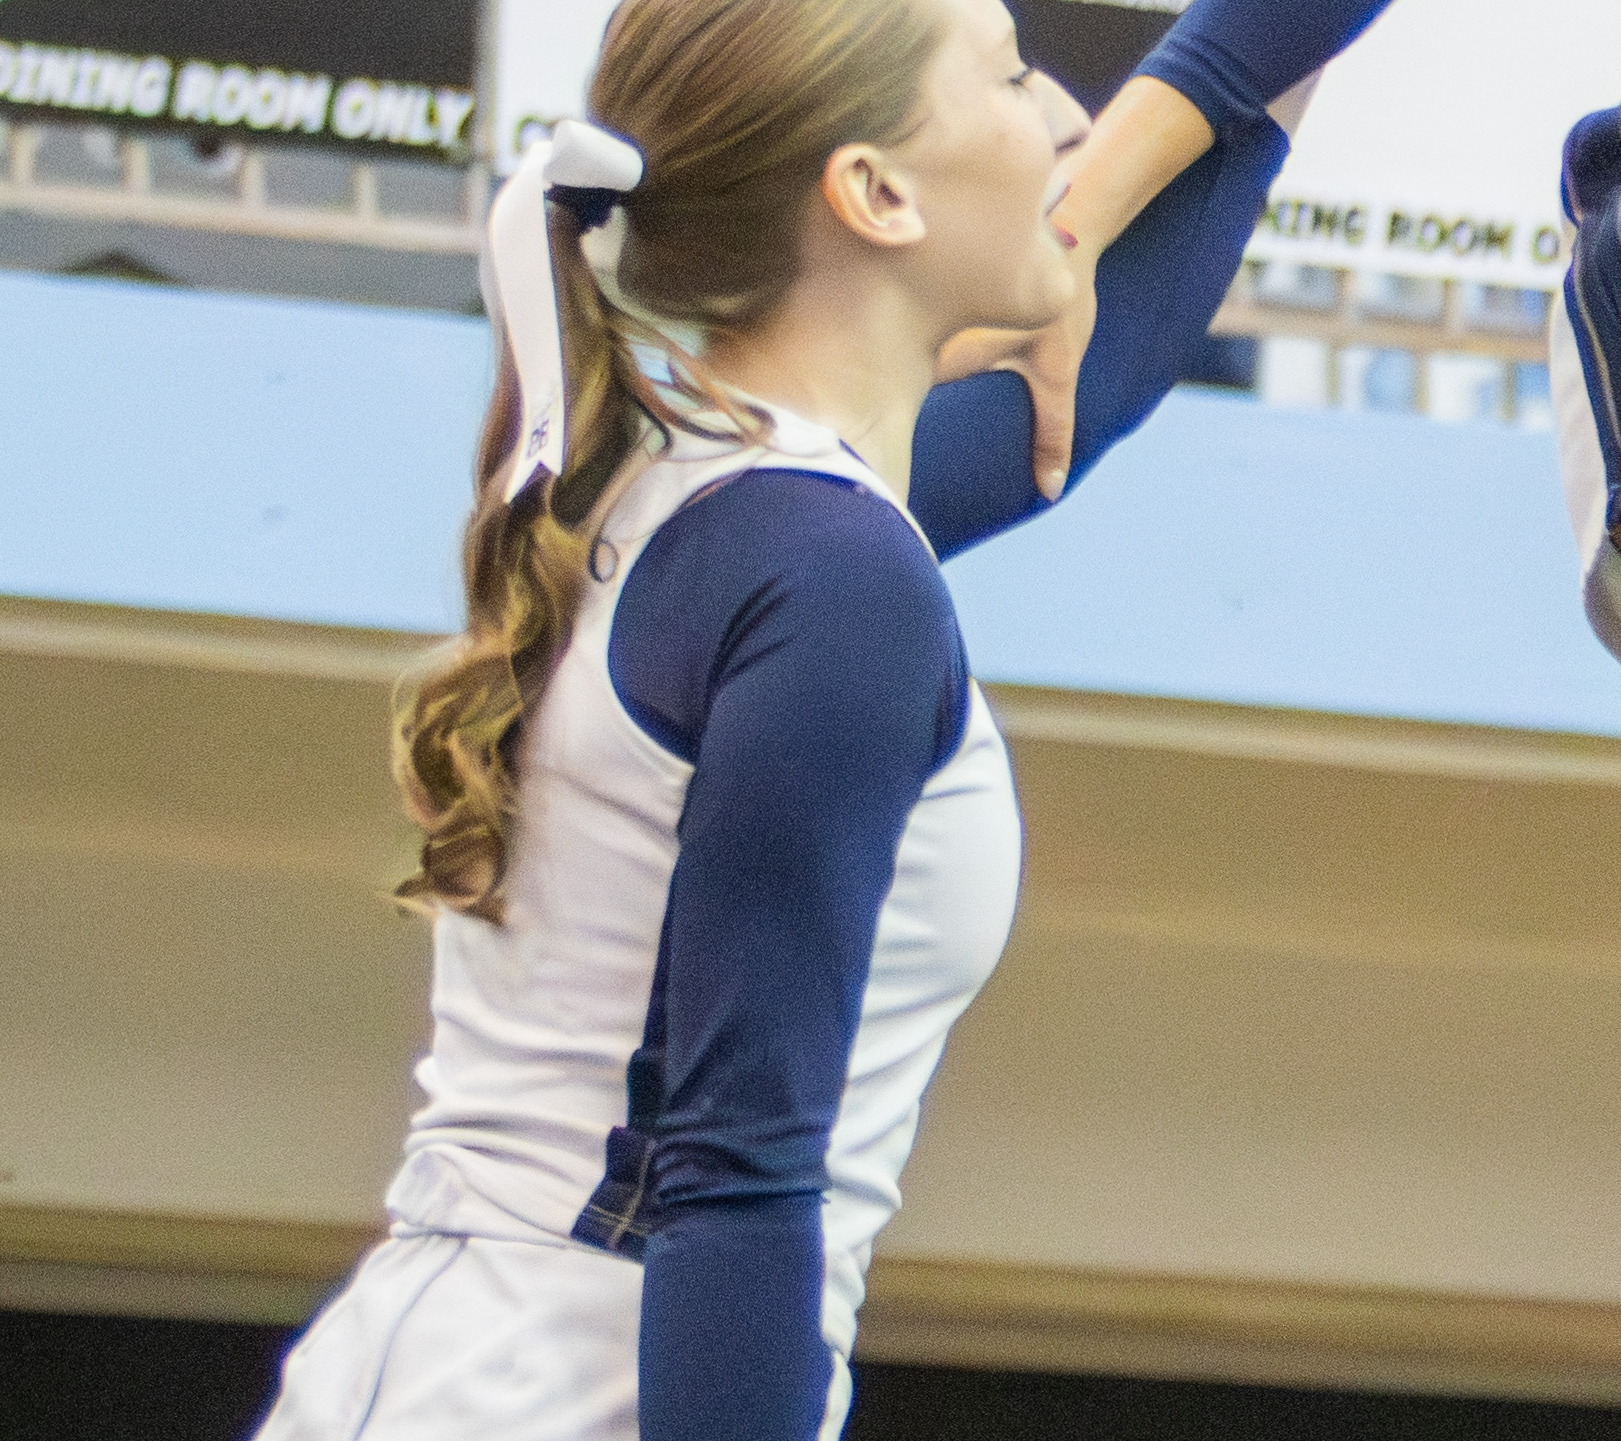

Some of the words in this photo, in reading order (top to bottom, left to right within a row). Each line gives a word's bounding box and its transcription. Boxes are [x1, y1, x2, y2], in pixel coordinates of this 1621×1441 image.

[176, 59, 332, 134] ROOM
[331, 80, 475, 148] ONLY
[1386, 207, 1515, 259] ROOM
